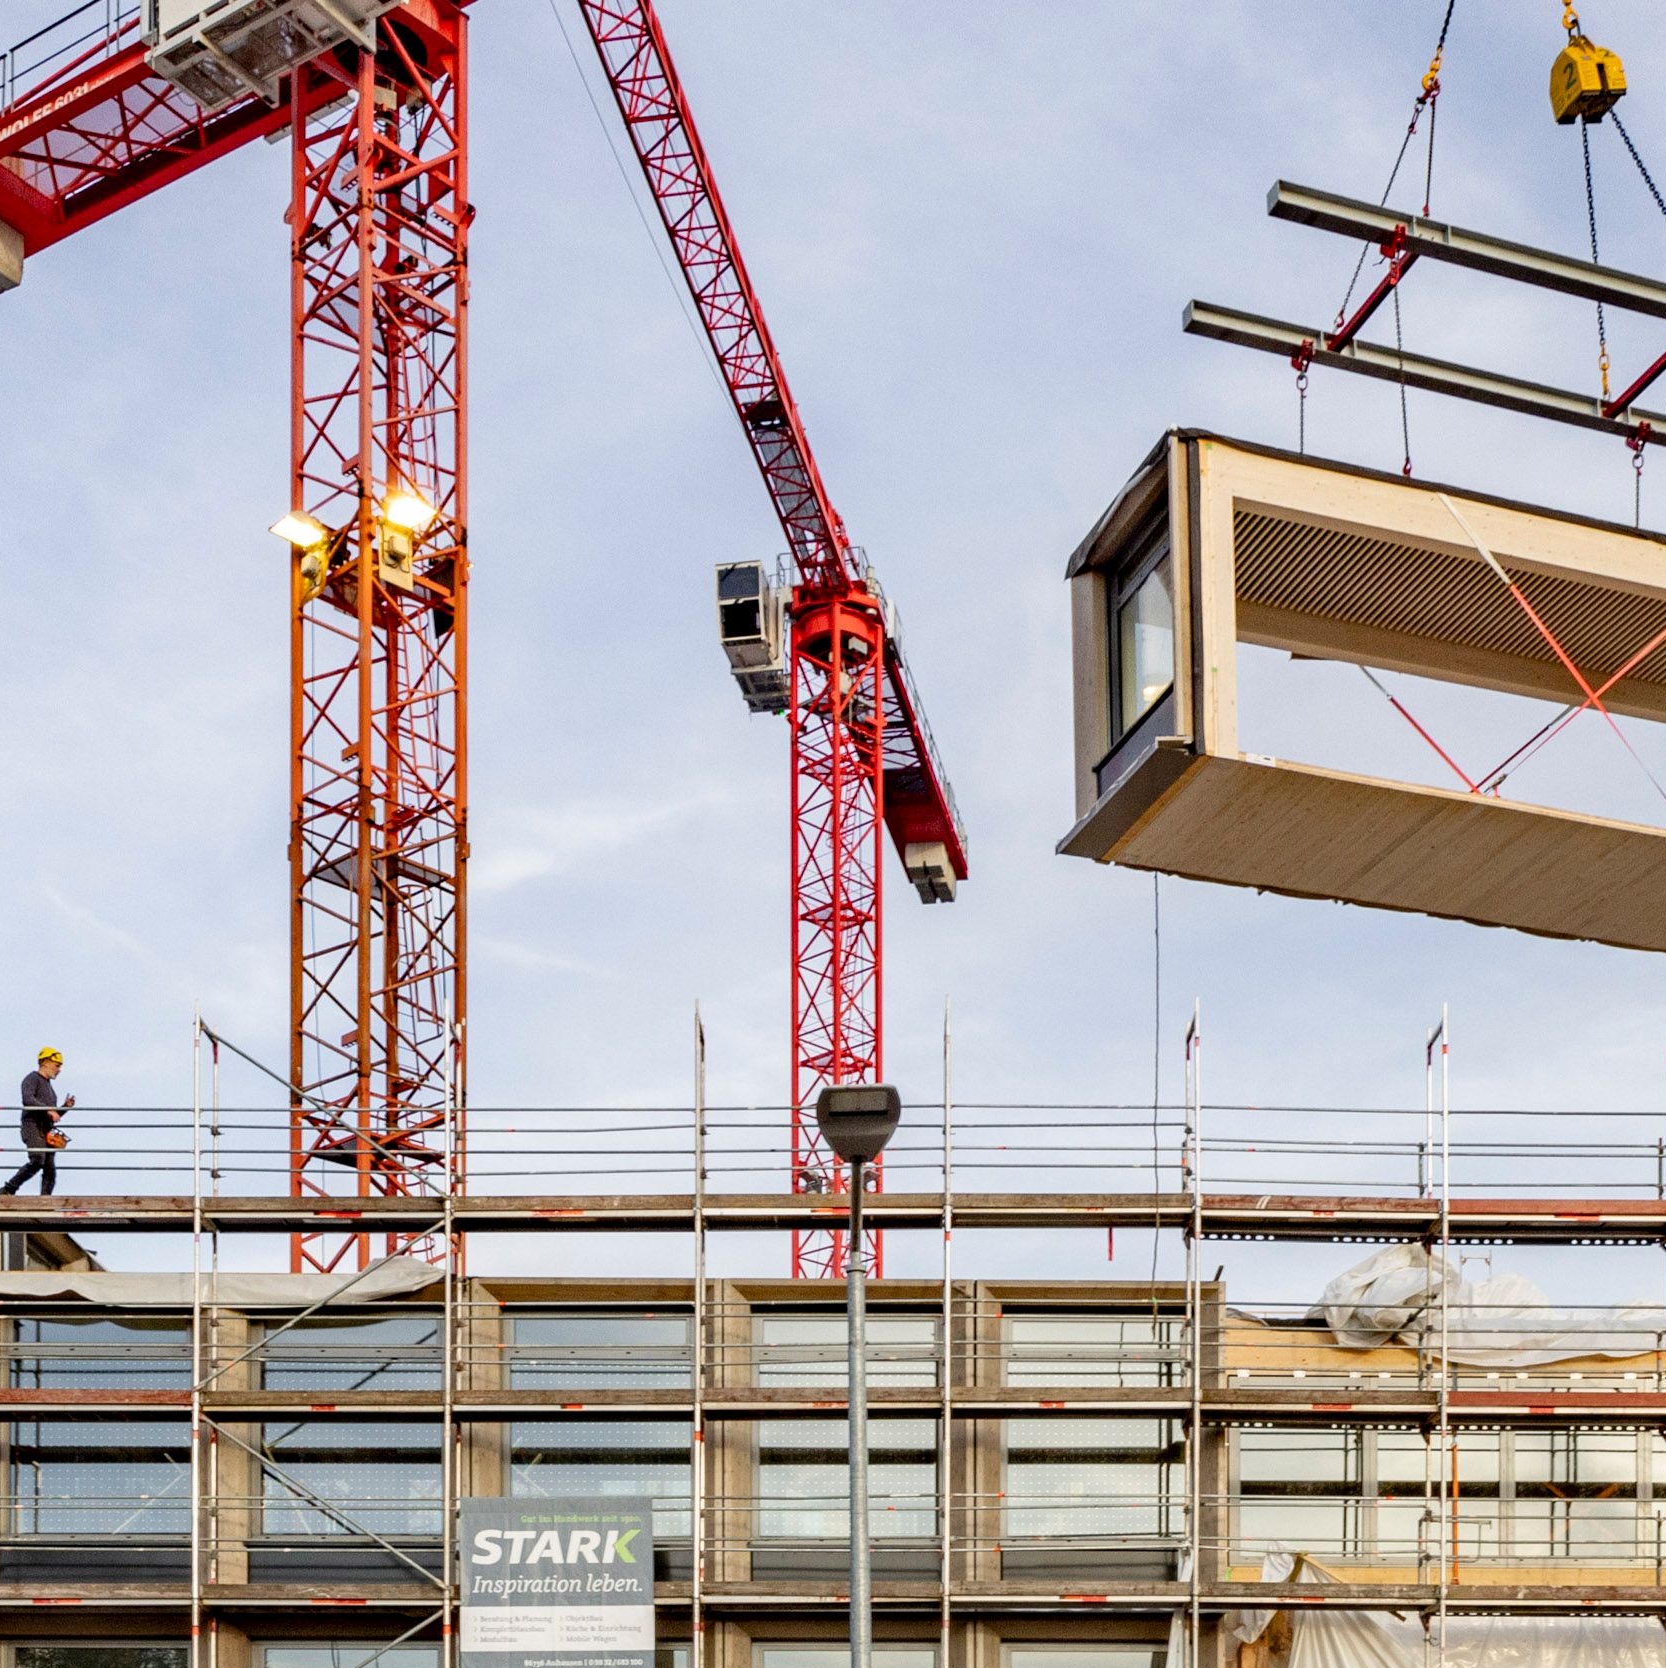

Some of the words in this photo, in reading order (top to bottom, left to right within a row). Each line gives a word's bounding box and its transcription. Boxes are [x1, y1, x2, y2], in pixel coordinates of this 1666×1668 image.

[471, 1529, 641, 1565] STARK
[473, 1575, 581, 1598] Inspiration
[586, 1574, 643, 1592] leben.
